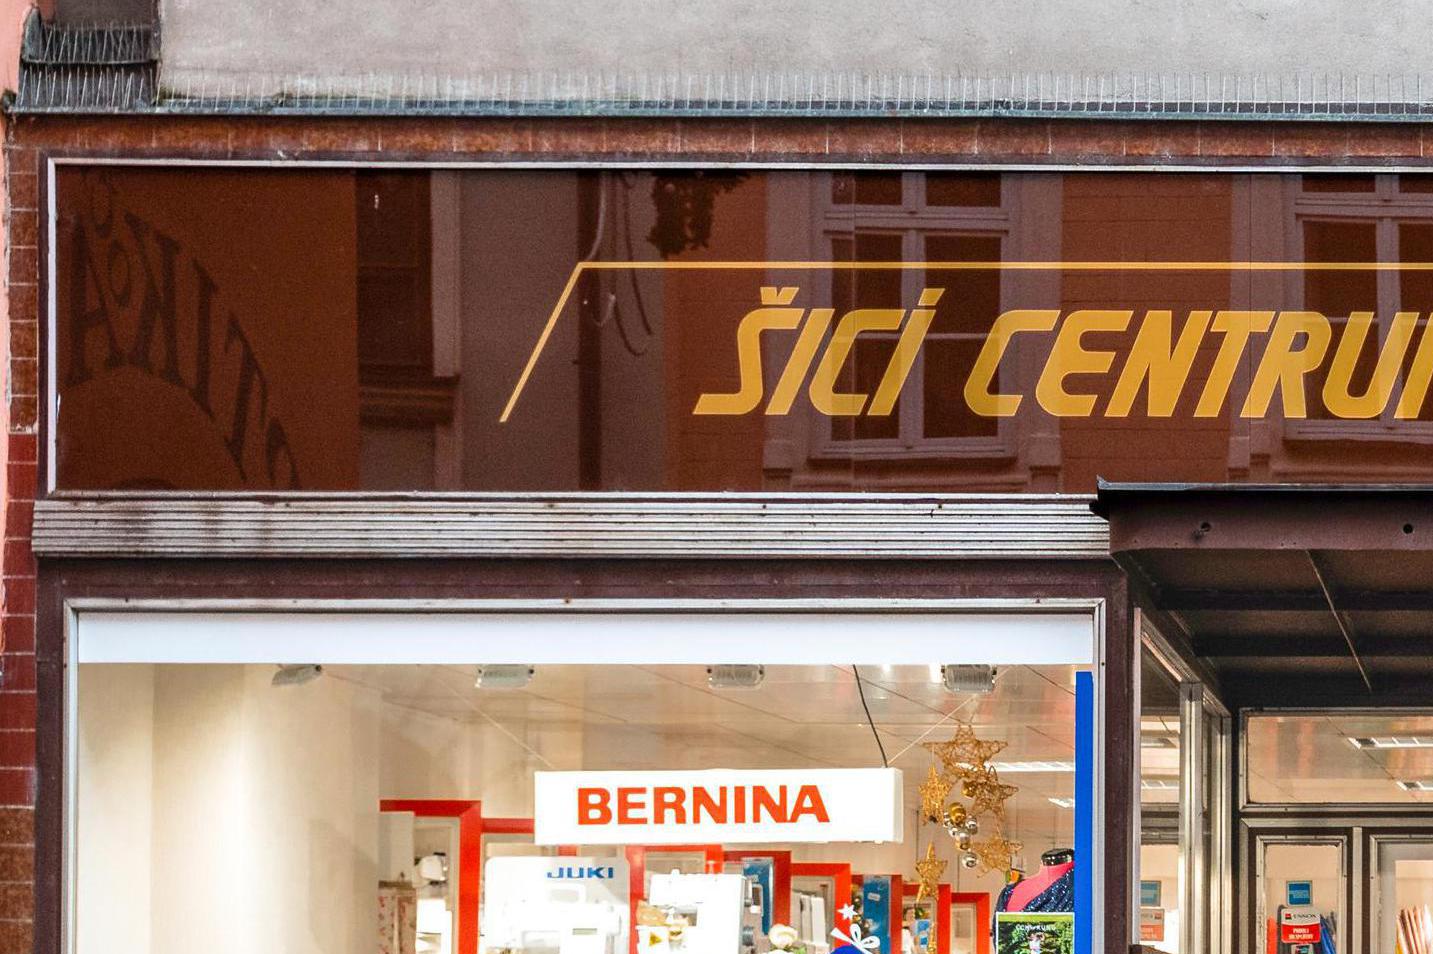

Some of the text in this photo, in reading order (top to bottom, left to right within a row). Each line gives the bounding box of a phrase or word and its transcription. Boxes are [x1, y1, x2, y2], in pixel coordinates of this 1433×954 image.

[692, 286, 946, 416] ŠICÍ
[577, 785, 831, 826] BERNINA
[547, 867, 614, 879] JUKI
